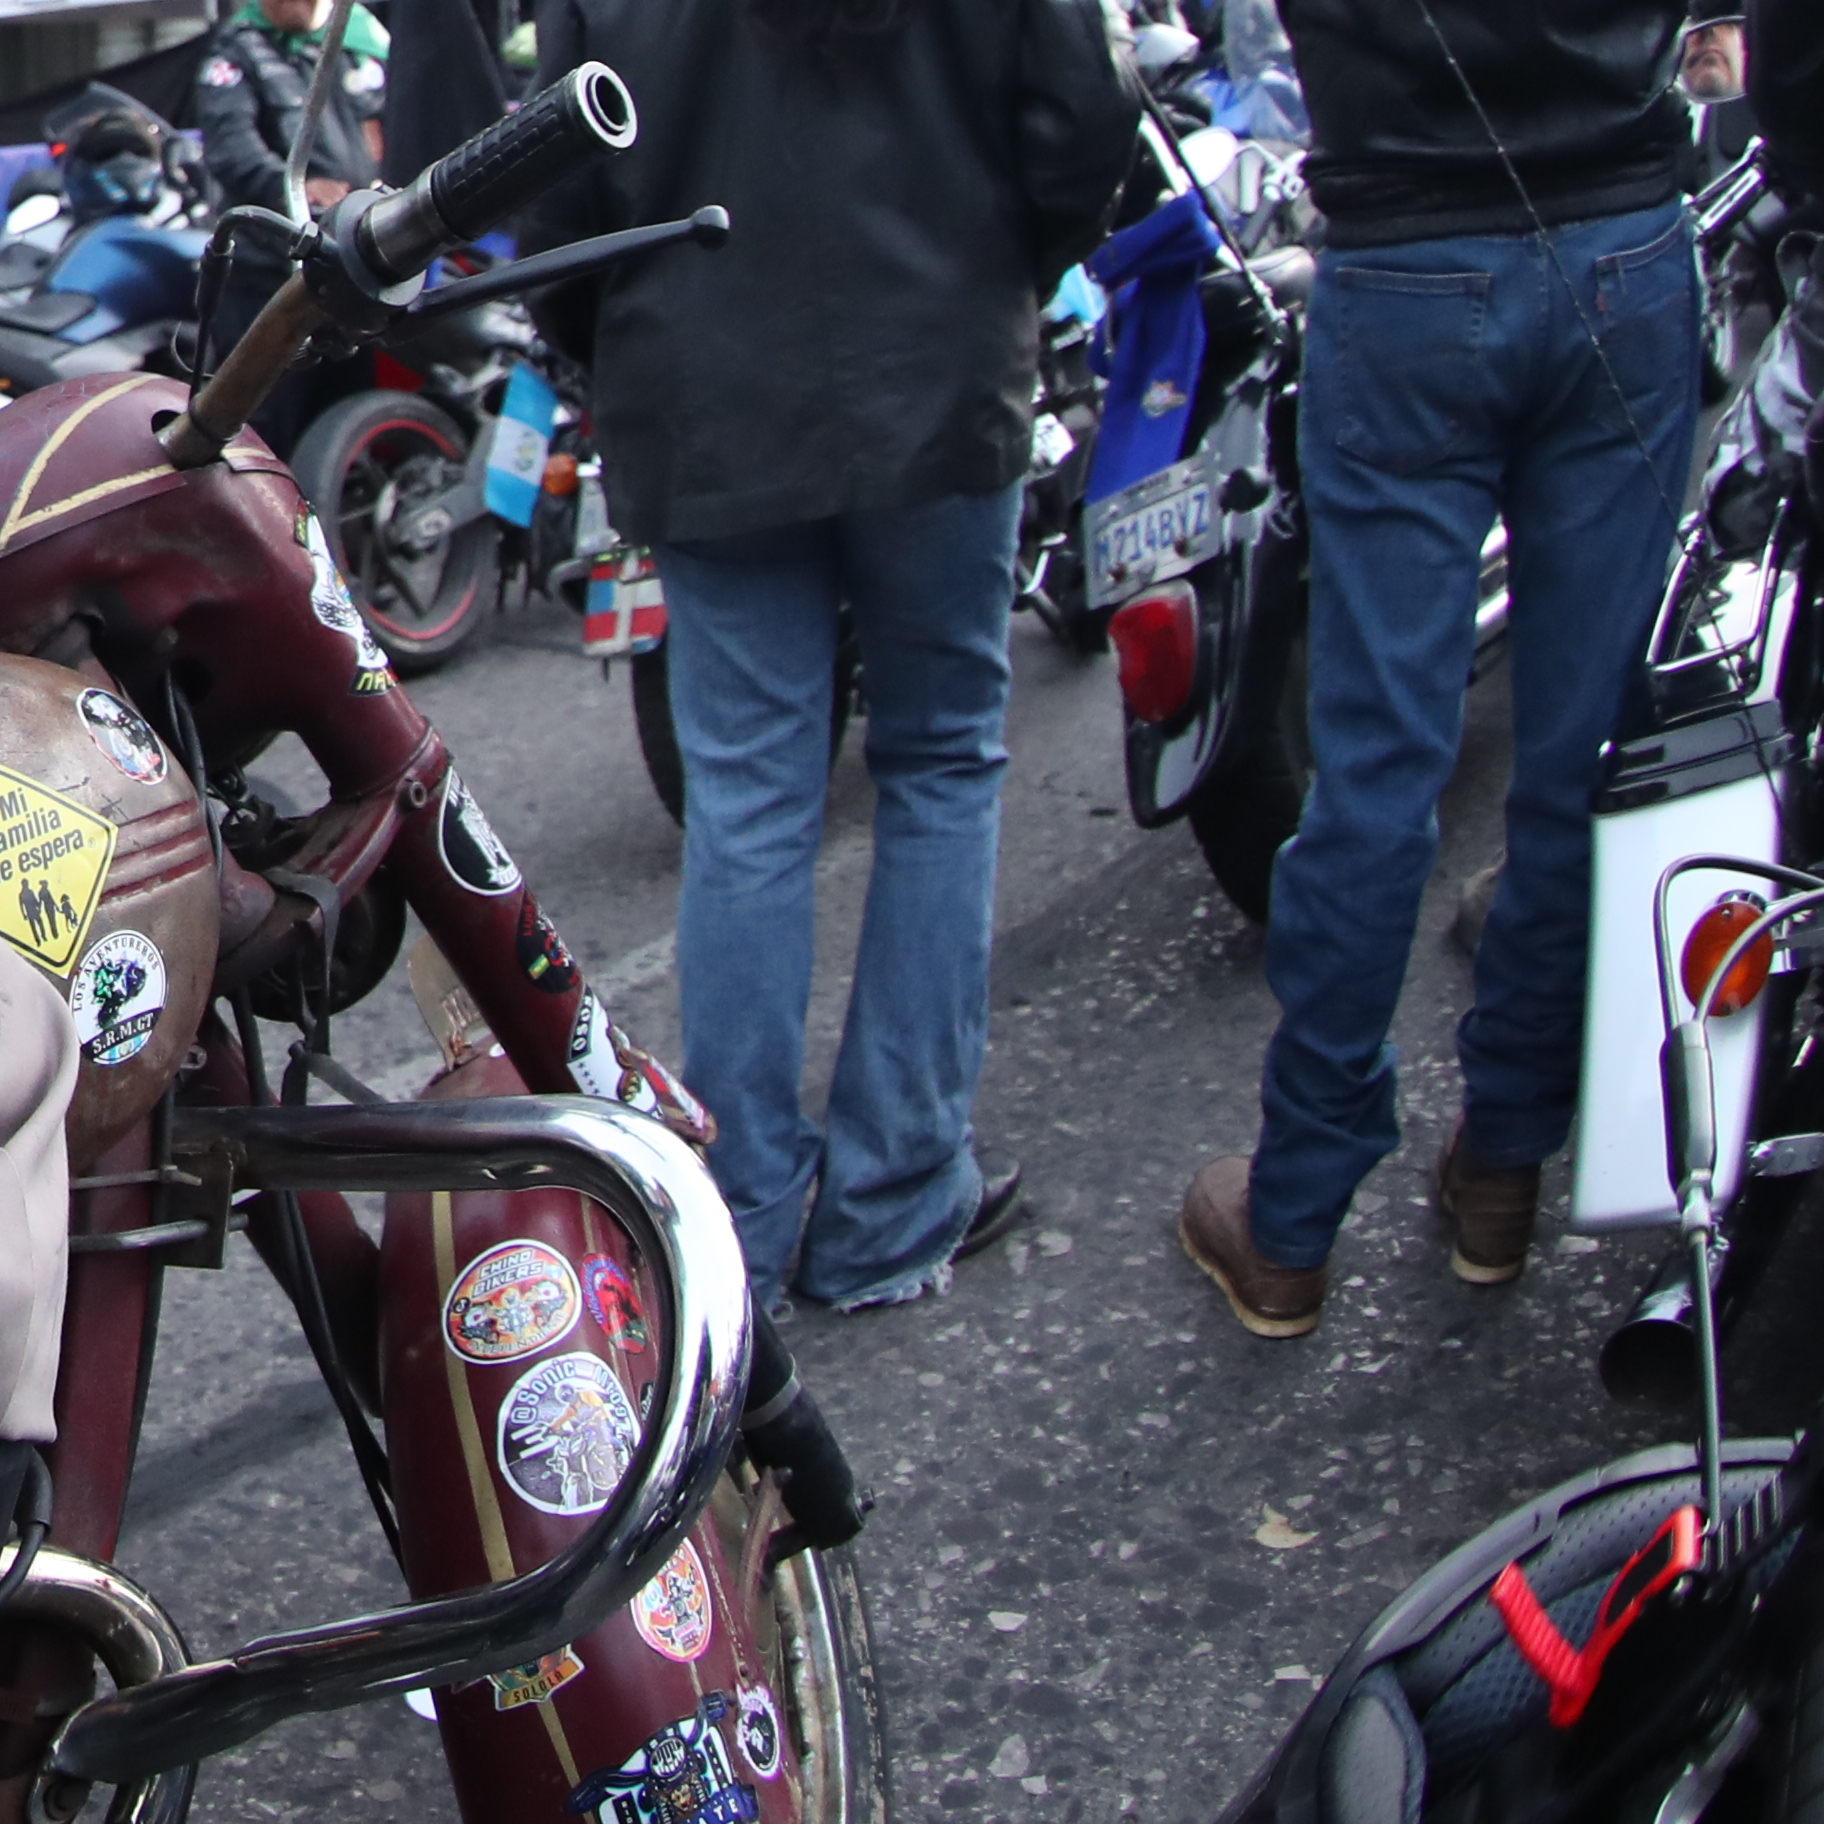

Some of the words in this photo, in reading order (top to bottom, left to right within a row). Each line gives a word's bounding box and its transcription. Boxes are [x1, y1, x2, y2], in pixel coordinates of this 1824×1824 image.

[18, 829, 84, 873] espera
[73, 982, 86, 1012] LOS
[473, 1262, 544, 1296] BIKERS
[513, 1669, 564, 1705] SOLOLA
